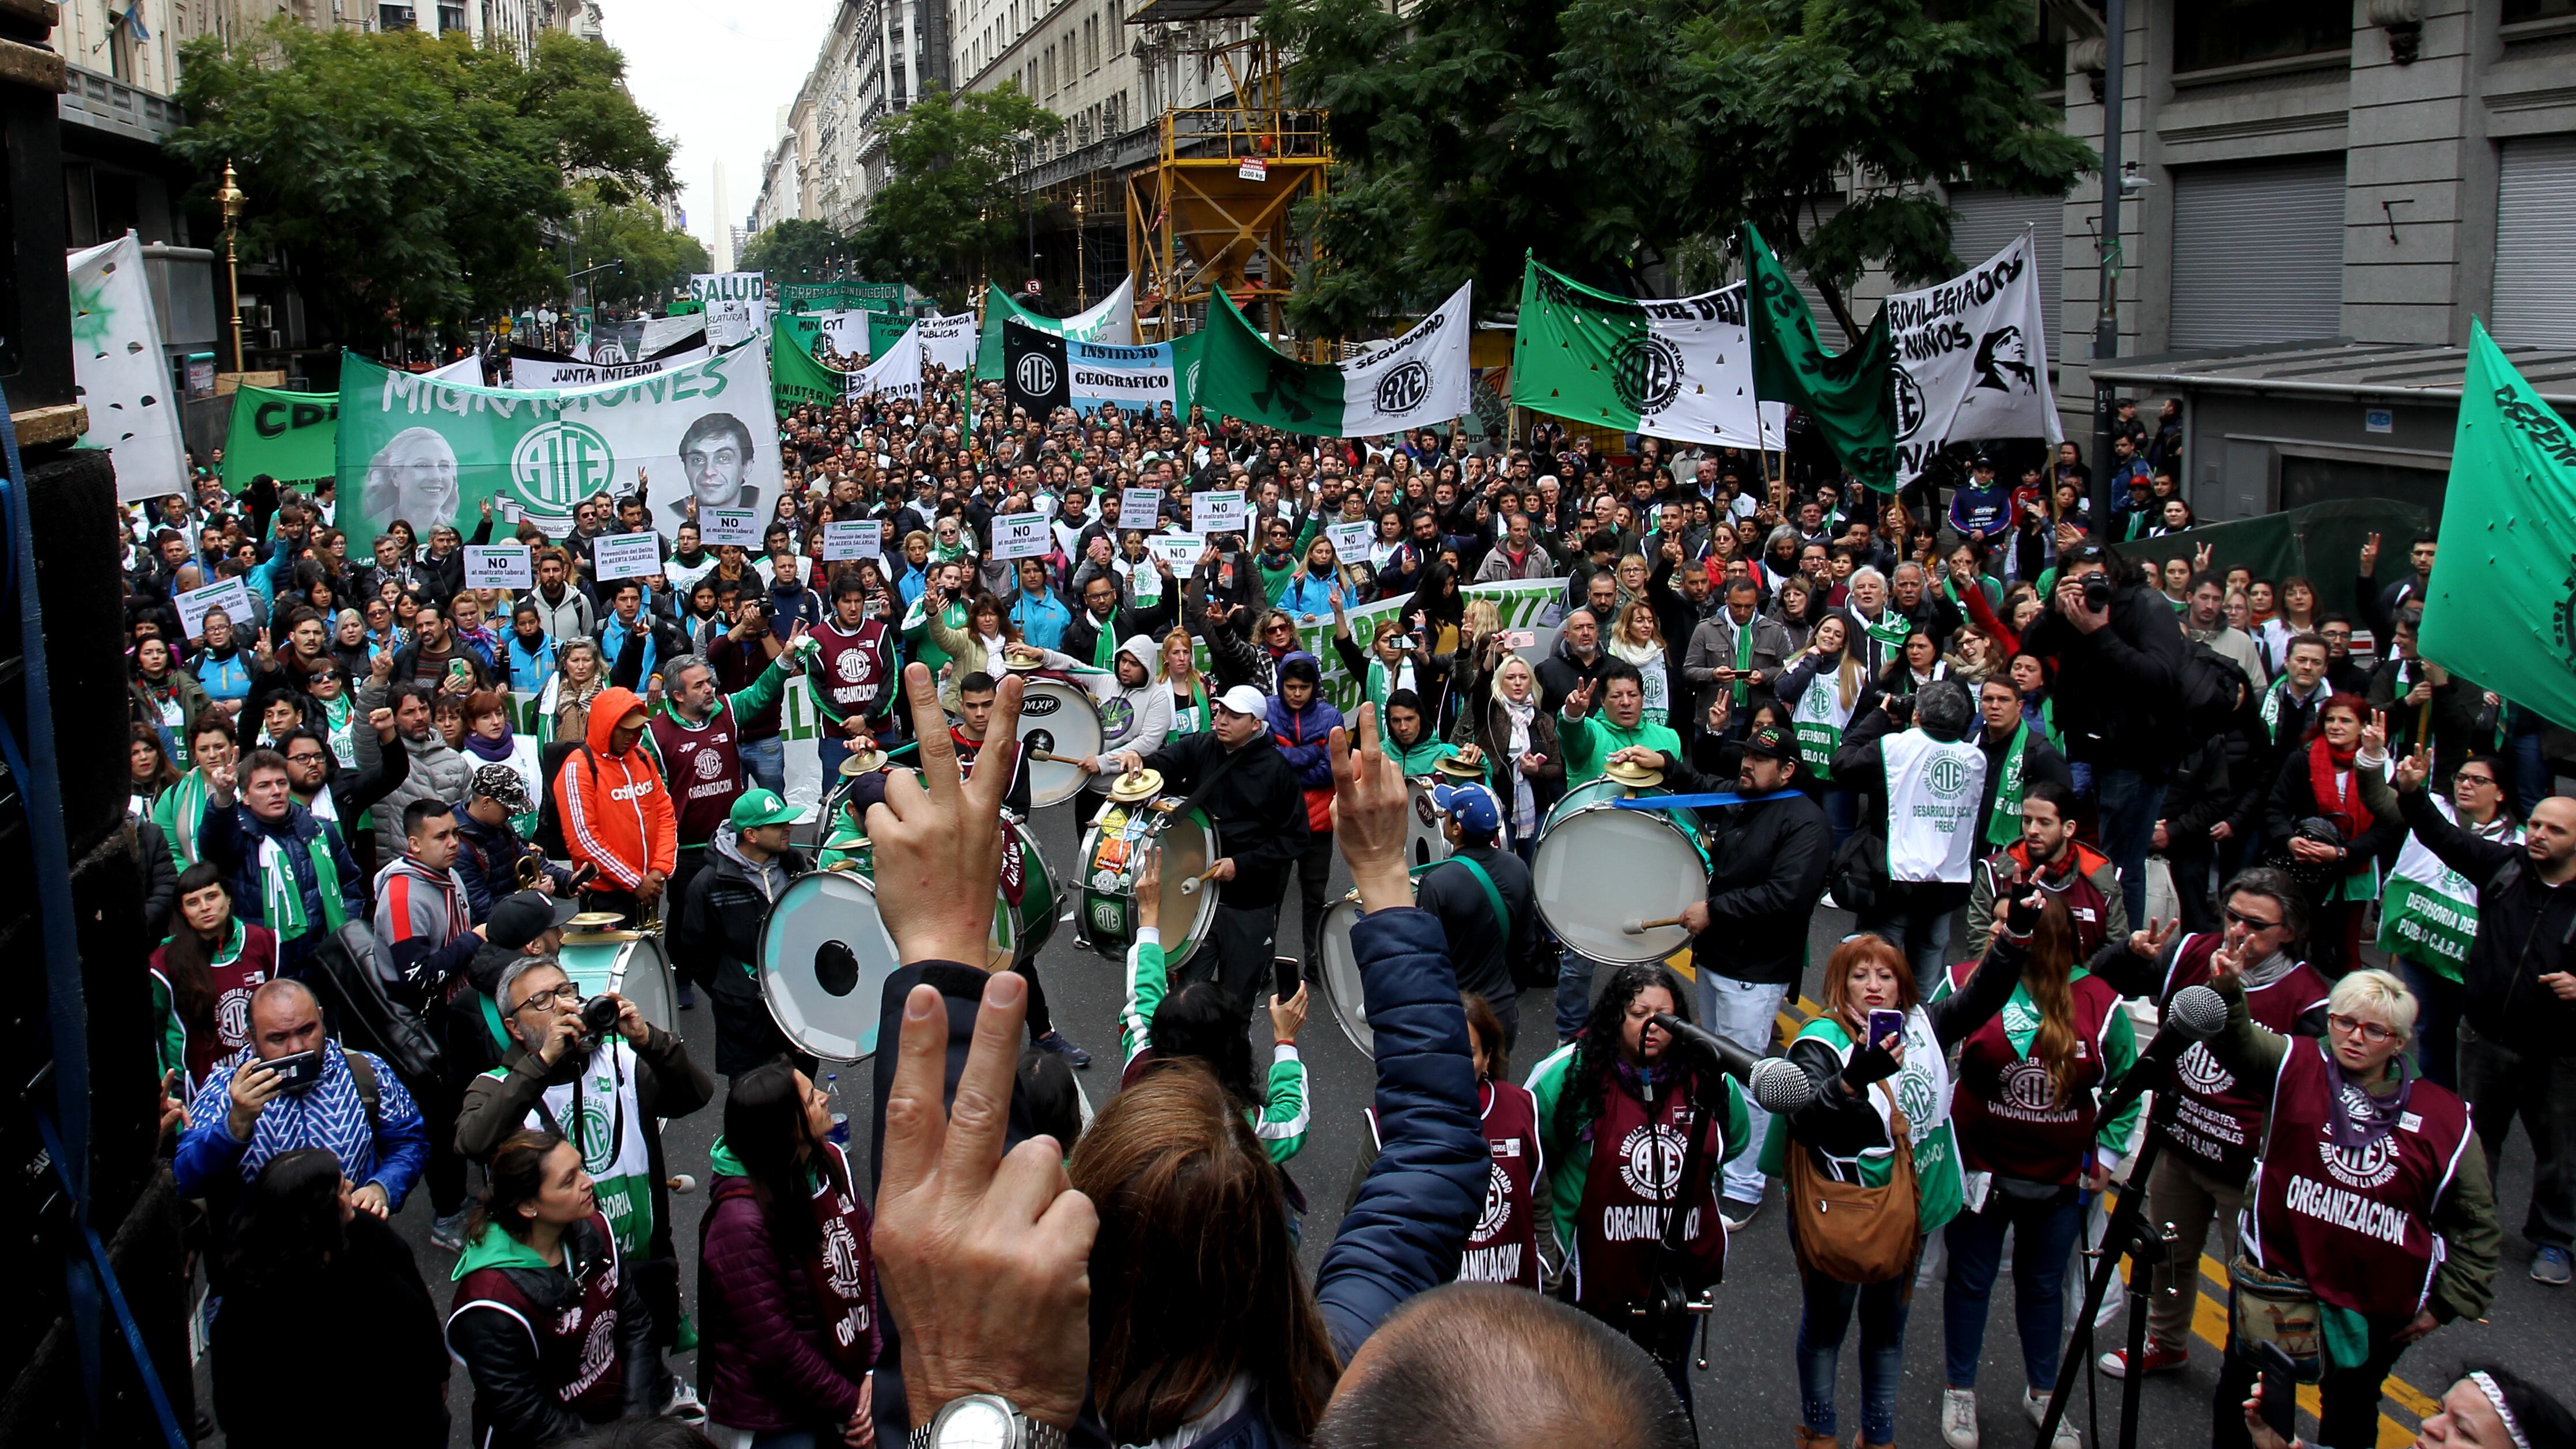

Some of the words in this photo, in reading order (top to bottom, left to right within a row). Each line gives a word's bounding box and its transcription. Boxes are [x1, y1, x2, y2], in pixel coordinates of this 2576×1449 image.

[691, 277, 763, 302] SALUD
[784, 285, 838, 299] FERREYRA
[1889, 251, 2023, 331] RIVILEGIADOS
[706, 313, 743, 324] SLATURA
[1691, 288, 1748, 327] DELI
[798, 320, 819, 332] MIN
[824, 317, 845, 331] CYT
[932, 315, 971, 328] VIVIENDA
[1355, 313, 1445, 370] SEGURIDAD
[1651, 332, 1662, 342] EL
[1904, 320, 1974, 362] NIÑOS
[1080, 344, 1158, 361] INSTITUTO
[552, 367, 596, 384] JUNTA
[601, 362, 662, 380] INTERNA
[1020, 357, 1052, 392] ATE
[1075, 372, 1169, 388] GEOGRAFICO
[1382, 365, 1423, 409] ATE
[255, 401, 339, 439] CD
[1651, 407, 1661, 415] LA
[519, 429, 604, 504] ATE
[1212, 503, 1228, 513] NO
[533, 524, 563, 533] grupación
[721, 518, 738, 527] NO
[1013, 525, 1031, 537] NO
[1344, 535, 1355, 545] NO
[487, 558, 507, 569] NO
[601, 548, 629, 558] Prevención
[628, 554, 654, 562] SALARIAL
[1170, 548, 1186, 558] NO
[844, 658, 863, 676] ATE
[699, 755, 717, 773] ATE
[1934, 762, 1960, 789] ATE
[611, 779, 653, 801] adidas
[688, 778, 733, 800] ORGANIZACION
[1098, 906, 1117, 932] ATE
[2457, 915, 2479, 937] DEL
[2429, 933, 2465, 961] C.A.B.A.
[2188, 1040, 2219, 1079] ATE
[2202, 1084, 2211, 1094] LA
[1661, 1123, 1670, 1135] EL
[2192, 1115, 2244, 1145] INVENCIBLES
[2319, 1141, 2333, 1164] PARA
[2327, 1162, 2358, 1188] LIBERAR
[2359, 1176, 2372, 1189] LA
[2370, 1162, 2399, 1187] NACION
[1619, 1165, 1632, 1186] PARA
[1631, 1182, 1658, 1201] LIBERA
[1486, 1225, 1495, 1239] LA
[1492, 1201, 1511, 1232] NACION
[2286, 1174, 2410, 1246] ORGANIZACION
[1459, 1243, 1522, 1284] ANIZACION
